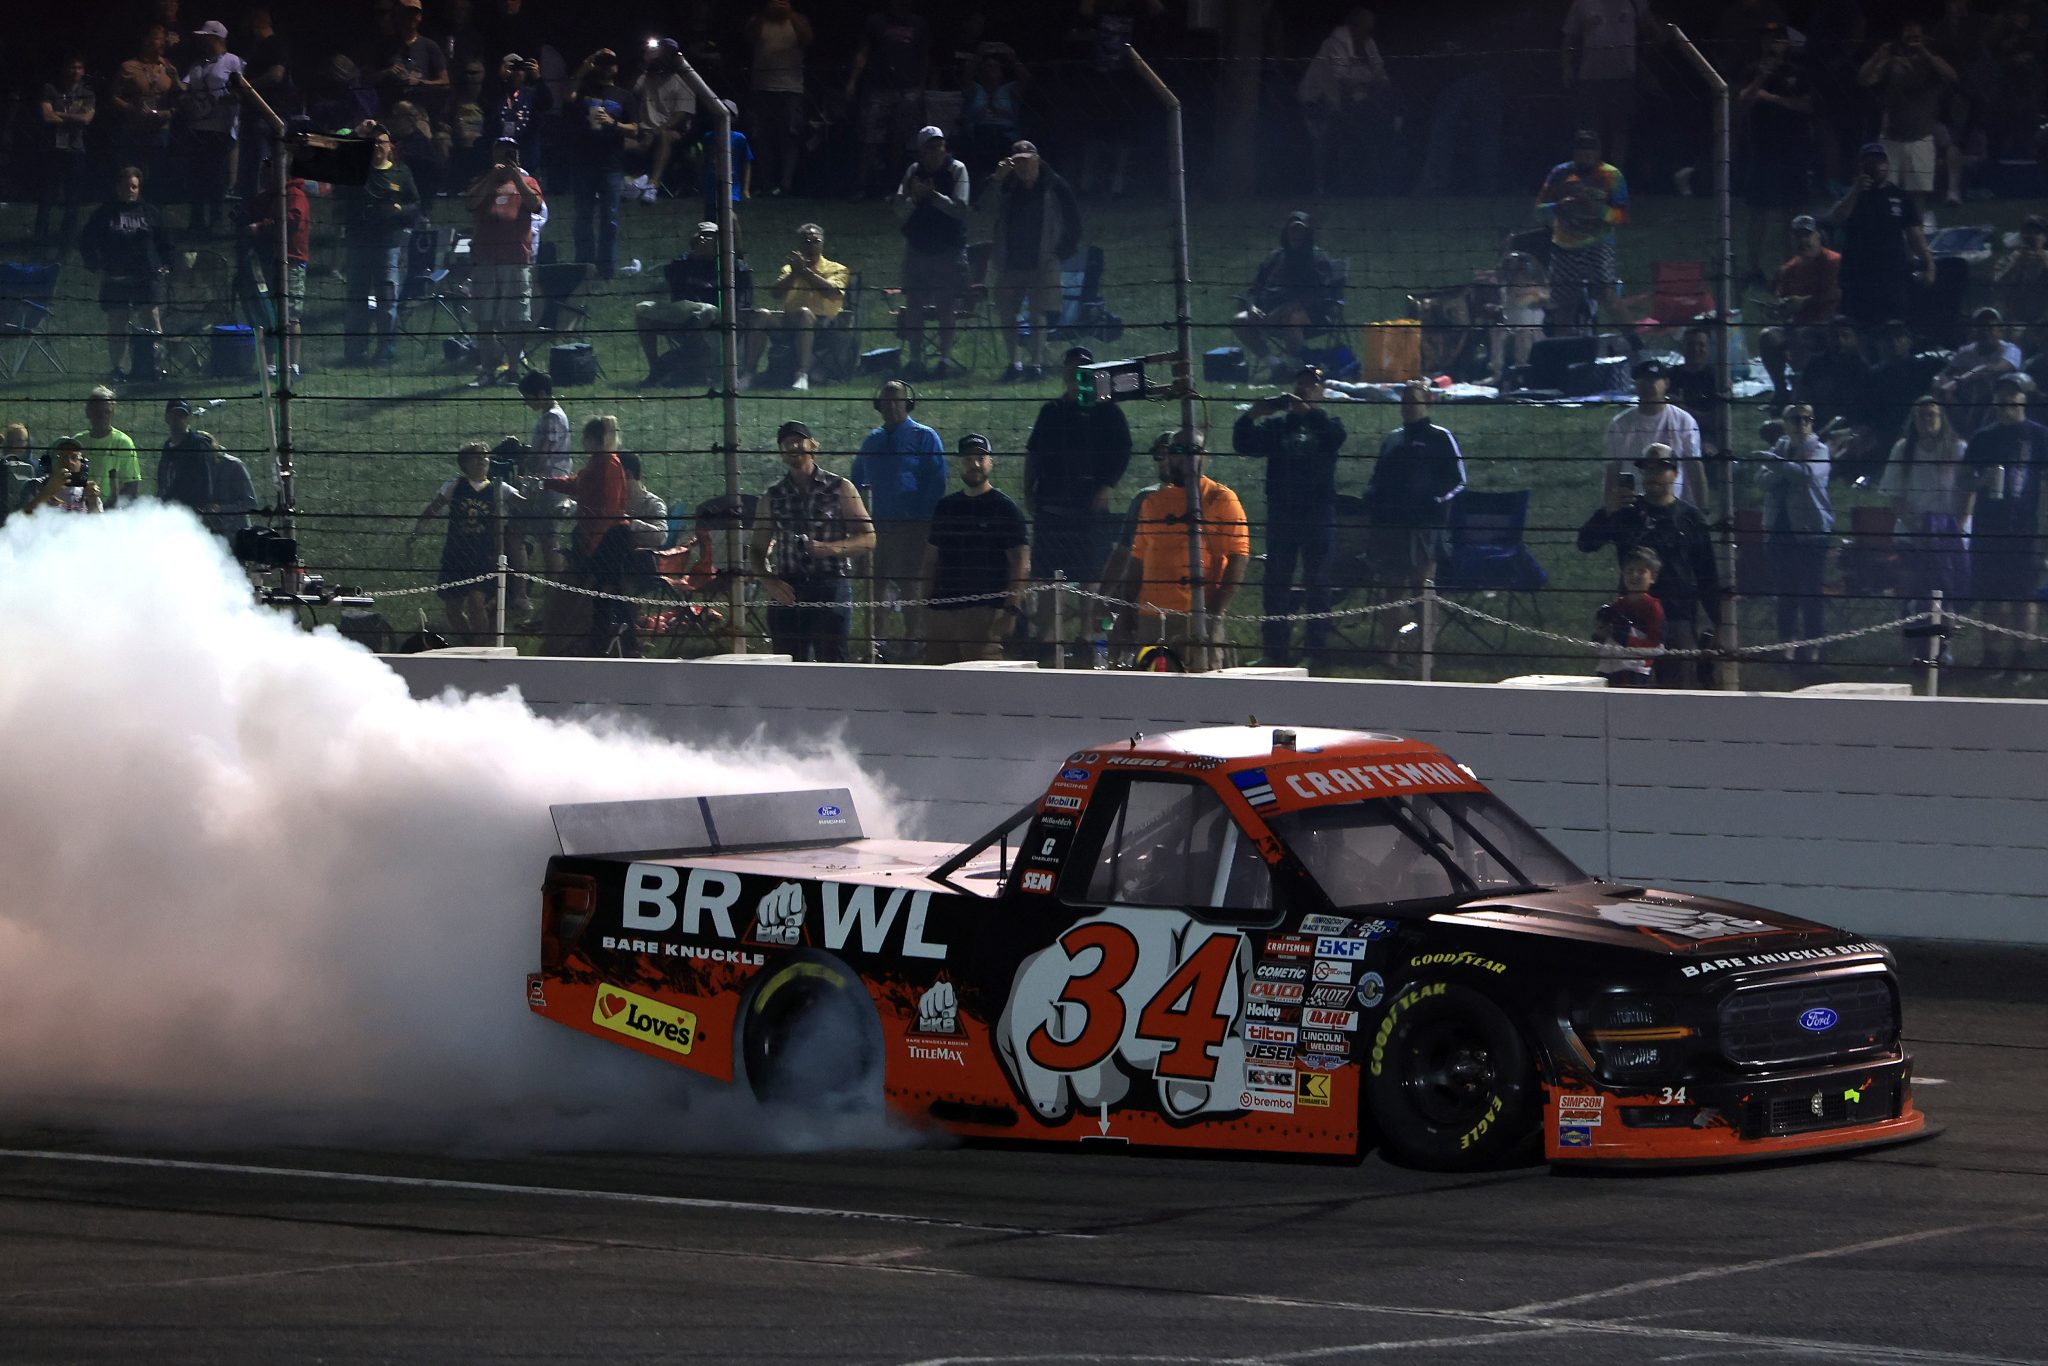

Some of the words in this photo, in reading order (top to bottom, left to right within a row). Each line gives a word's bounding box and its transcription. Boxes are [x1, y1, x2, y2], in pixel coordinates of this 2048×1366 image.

[1106, 756, 1170, 767] RIGGS
[1285, 762, 1466, 799] CRAFTSMAN
[1047, 797, 1069, 806] Mobil
[1031, 855, 1060, 864] CHARLOTTE
[1022, 872, 1053, 892] SEM
[602, 936, 659, 955] BARE
[665, 943, 765, 966] KNUCKLE
[1267, 942, 1311, 953] CRAFTSMAN
[1317, 940, 1364, 957] SKF
[1410, 951, 1507, 974] GOODYEAR
[1681, 956, 1746, 979] BARE
[1747, 947, 1837, 966] KNUCKLE
[1256, 965, 1306, 979] COMETIC
[1250, 983, 1303, 998] CALICO
[1313, 987, 1350, 1002] KLOTZ
[1026, 921, 1246, 1083] 34
[1246, 1003, 1281, 1021] Holley
[1310, 1010, 1351, 1026] DART
[1806, 1010, 1831, 1028] Ford
[1248, 1026, 1295, 1042] tilton
[1303, 1031, 1342, 1043] LINCOLN
[1370, 982, 1448, 1077] GOODYEAR
[1246, 1044, 1295, 1061] JESEL
[1310, 1042, 1345, 1053] WELDERS
[1254, 1096, 1293, 1109] brembo
[1561, 1096, 1602, 1108] SIMPSON
[1658, 1086, 1686, 1105] 34
[1460, 1095, 1503, 1150] EAGLE
